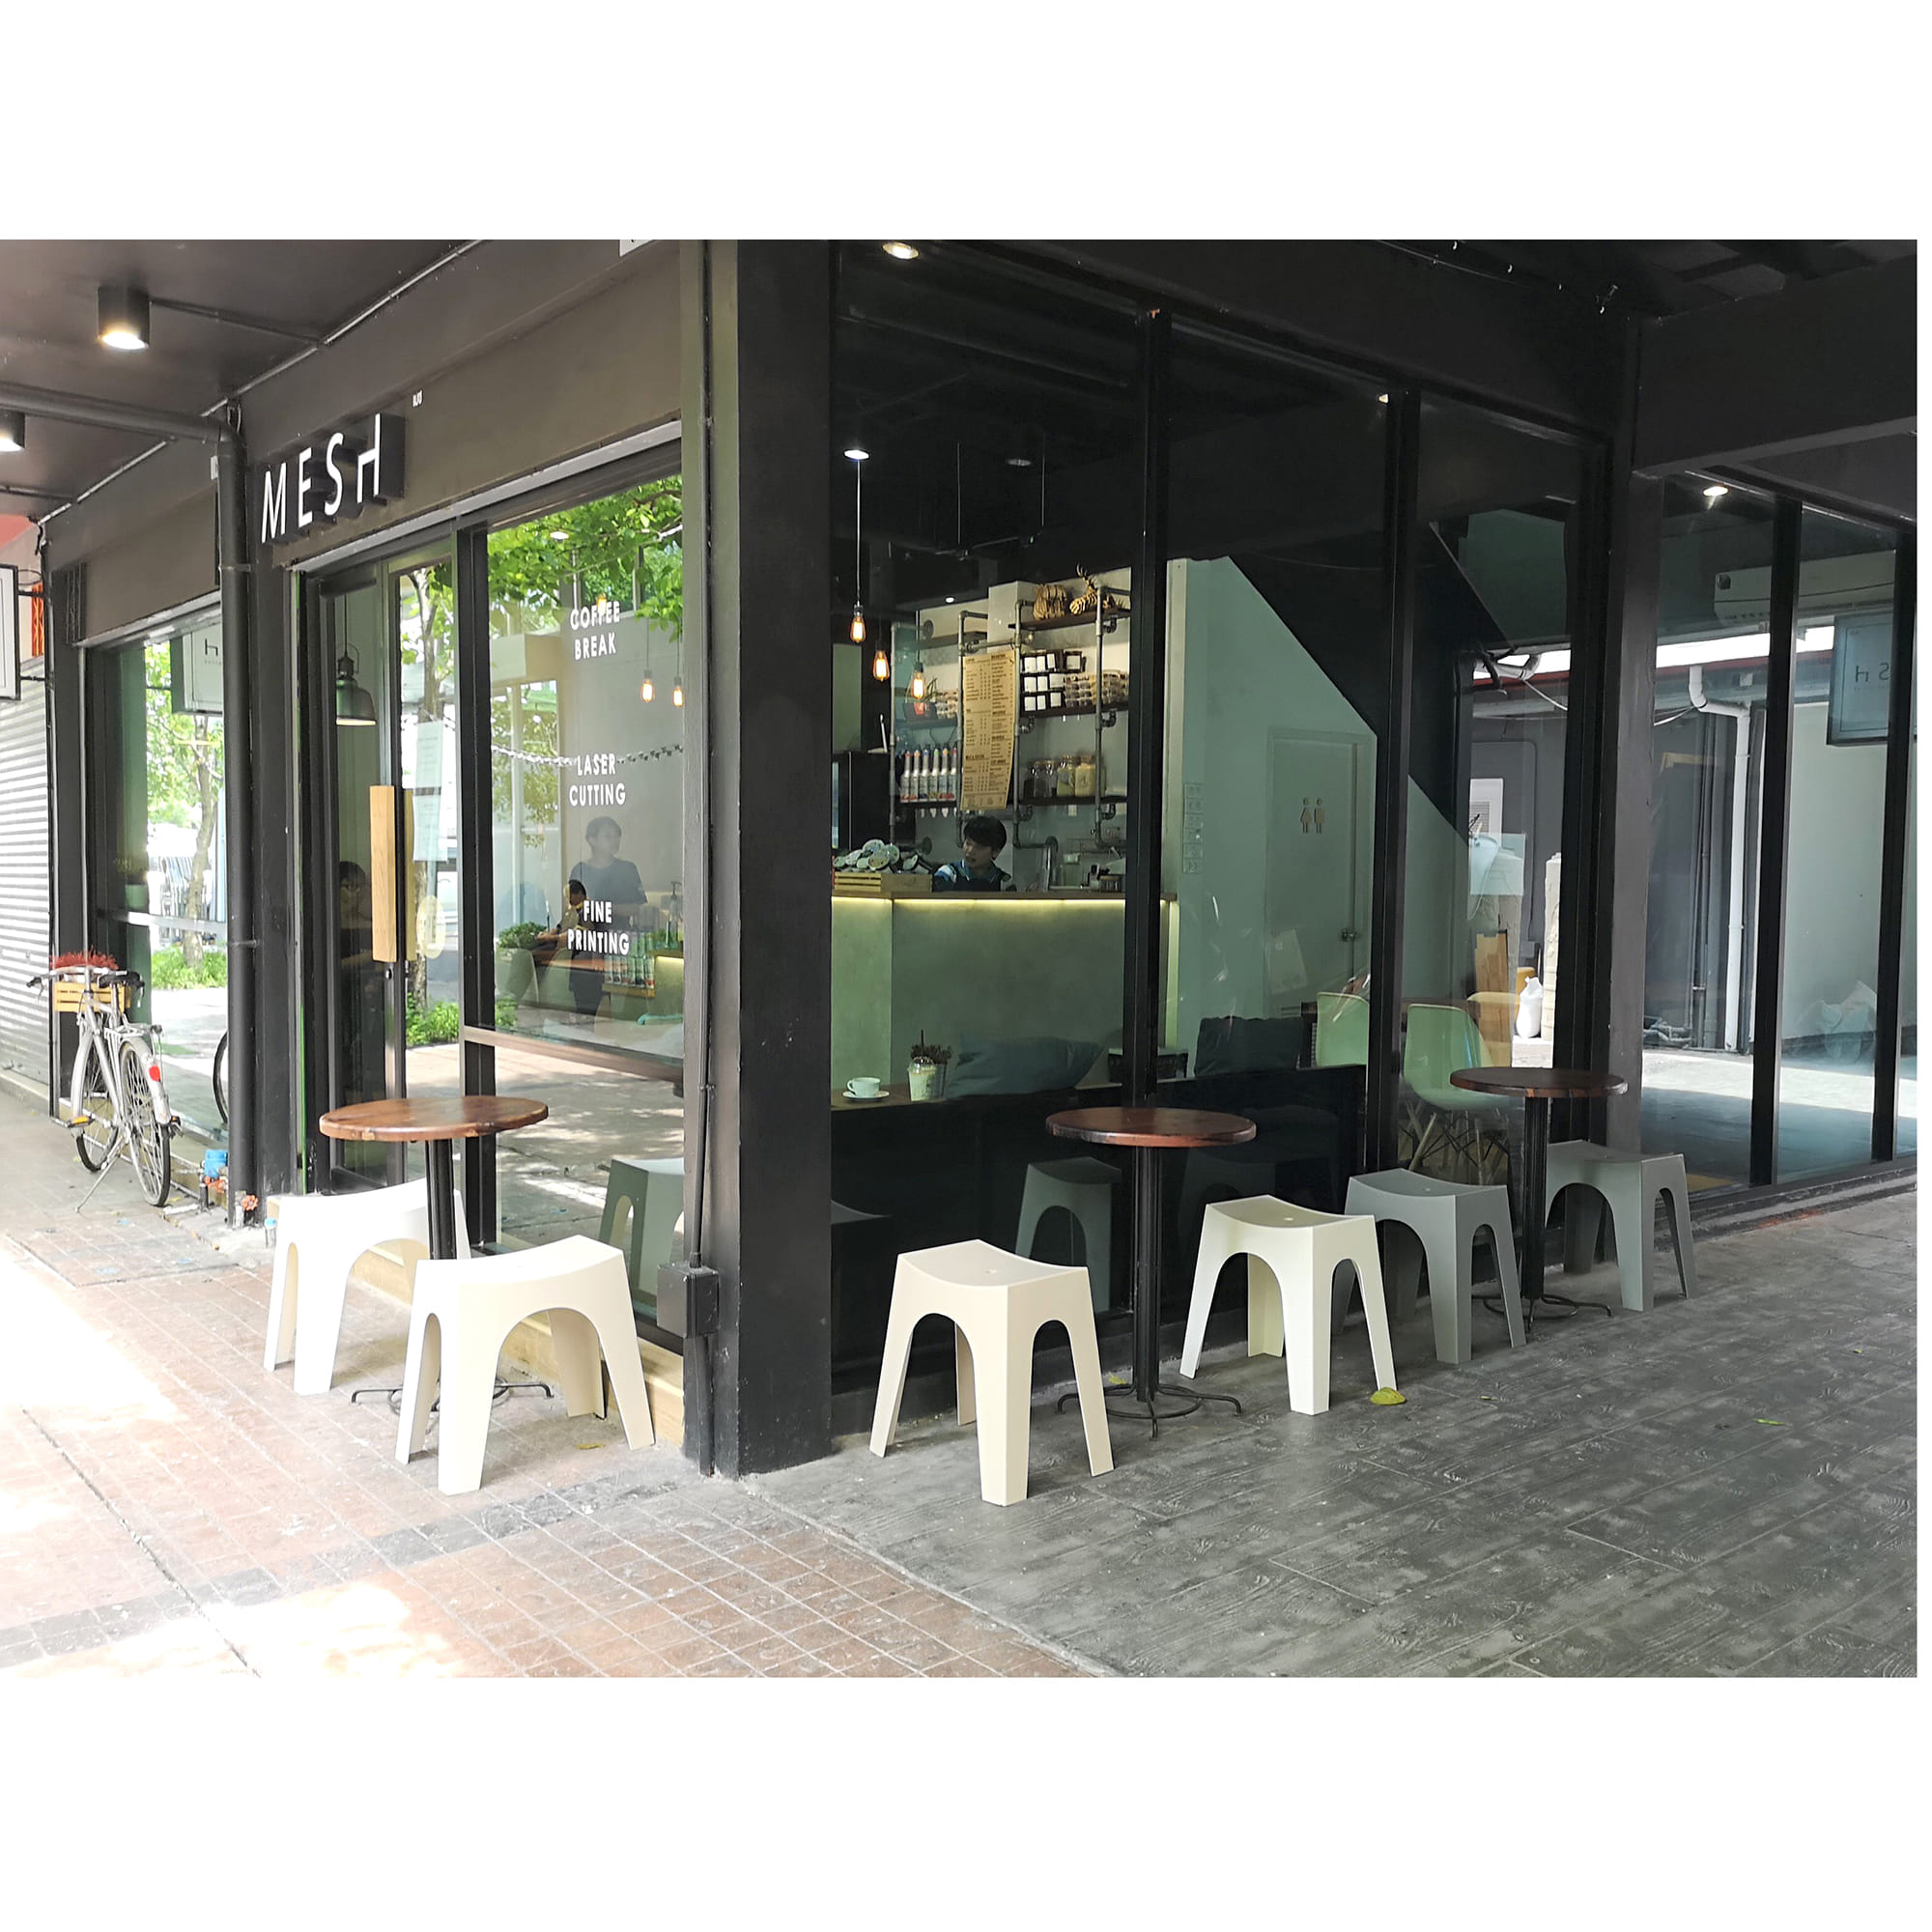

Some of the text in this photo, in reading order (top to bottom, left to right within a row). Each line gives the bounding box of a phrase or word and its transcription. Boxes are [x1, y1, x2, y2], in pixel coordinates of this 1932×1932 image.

[261, 412, 381, 544] MESH
[570, 601, 620, 630] COFFEE
[575, 632, 616, 661] BREAK
[577, 753, 615, 776] LASER
[569, 782, 626, 807] CUTTING
[583, 900, 612, 923] FINE
[568, 928, 629, 955] PRINTING
